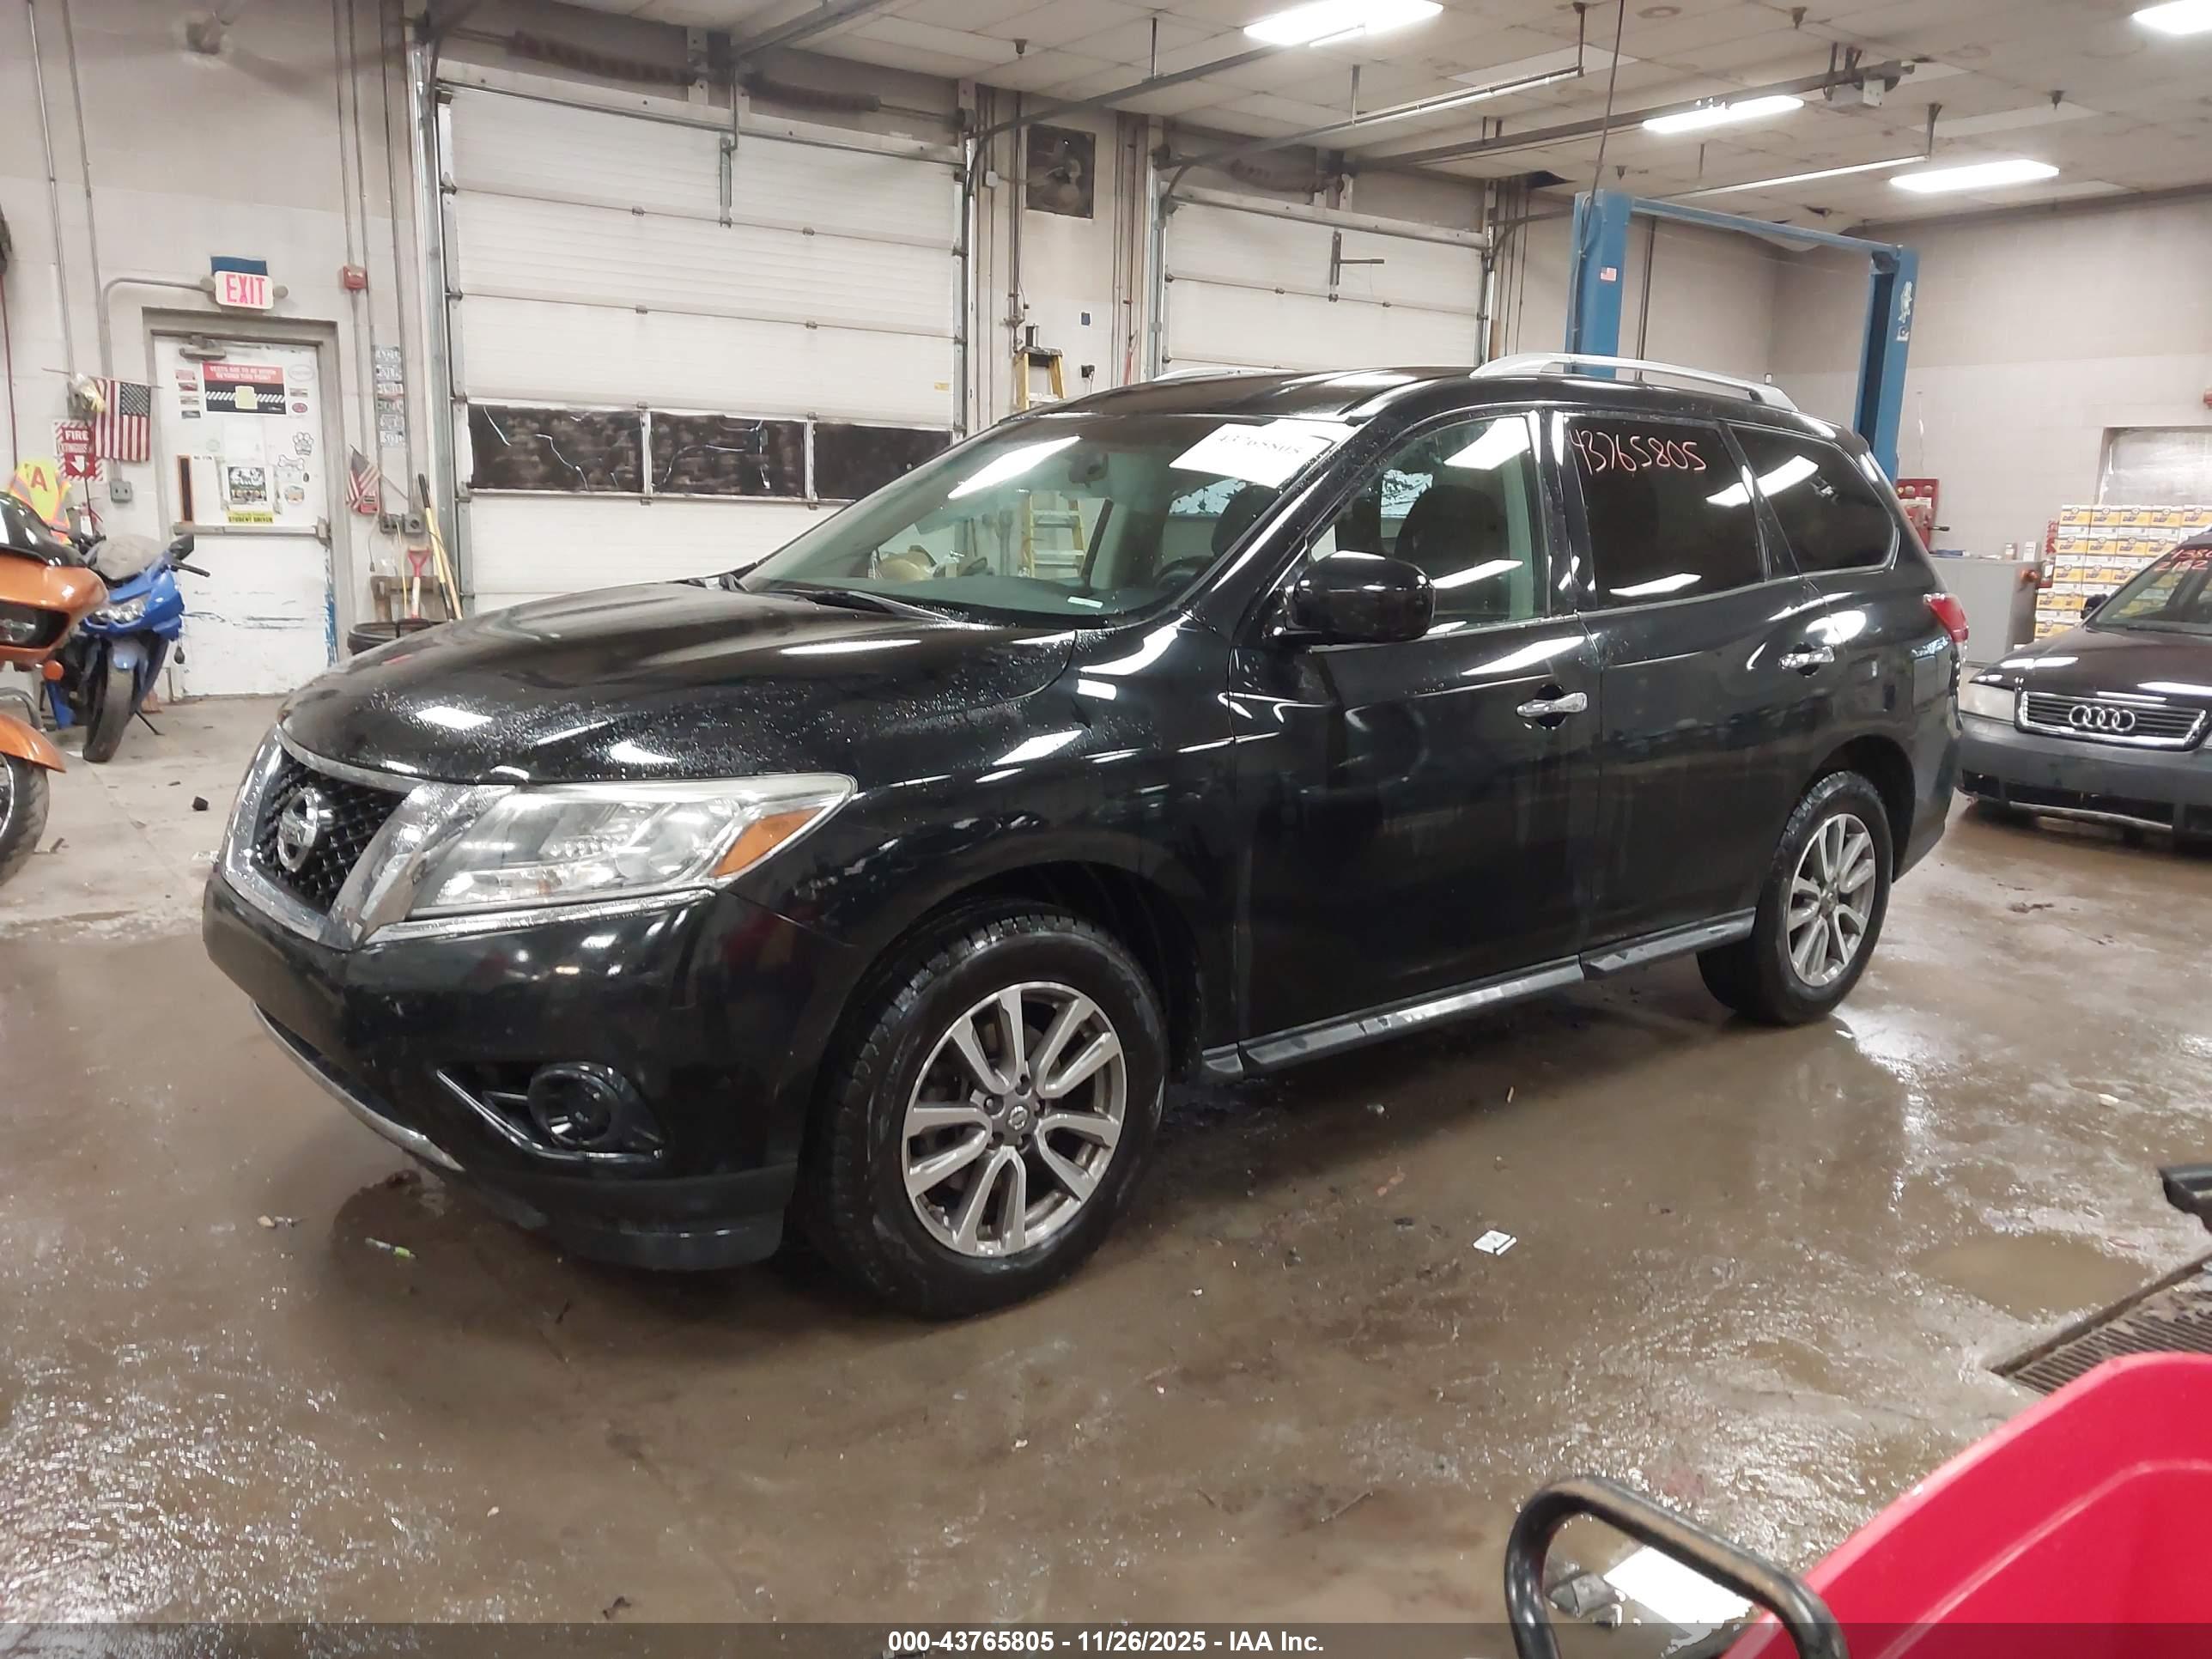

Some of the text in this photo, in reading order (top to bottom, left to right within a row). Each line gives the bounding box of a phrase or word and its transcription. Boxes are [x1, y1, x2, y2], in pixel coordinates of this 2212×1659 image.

[226, 274, 265, 305] EXIT
[64, 429, 89, 441] FIRE
[1569, 428, 1707, 475] 43765805
